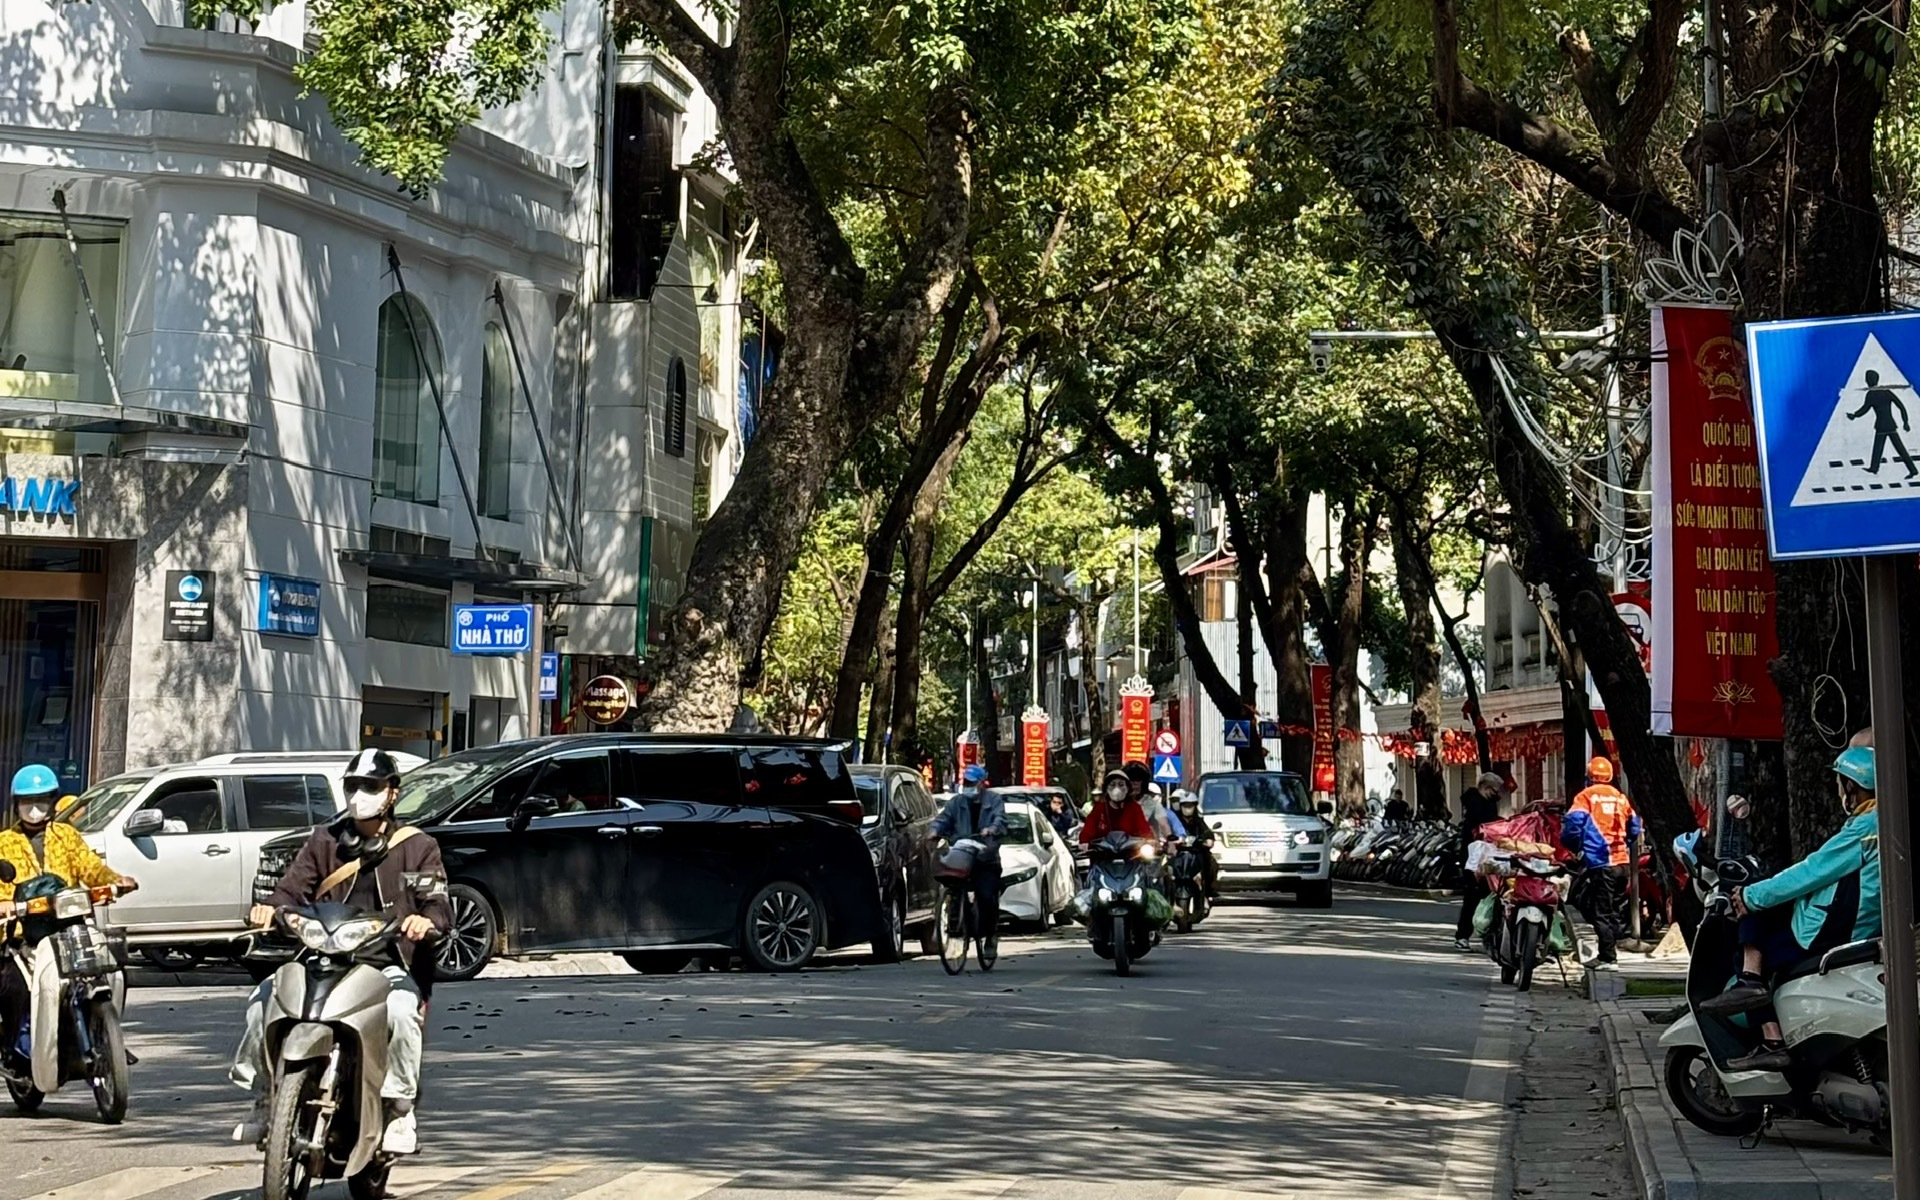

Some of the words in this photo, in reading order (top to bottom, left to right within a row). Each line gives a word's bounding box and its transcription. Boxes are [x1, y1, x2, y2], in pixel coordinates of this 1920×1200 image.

[1702, 414, 1731, 448] QUỐC
[1733, 418, 1751, 452] HỘI
[1690, 457, 1703, 487] LÀ
[1704, 454, 1730, 488] BIỂU
[1731, 462, 1763, 494] TƯỢN
[1676, 499, 1696, 528] SỨC
[1697, 505, 1729, 534] MẠNH
[1731, 506, 1755, 530] TINH
[1696, 546, 1712, 575] ĐẠI
[1714, 542, 1745, 571] ĐOÀN
[1746, 541, 1764, 573] KẾT
[485, 609, 511, 623] PHỐ
[1695, 583, 1721, 613] TOÀN
[1723, 584, 1745, 613] DÂN
[1747, 584, 1766, 620] TỘC
[460, 624, 492, 645] NHÀ
[494, 623, 525, 645] THỜ
[1705, 626, 1728, 660] VIỆT
[1729, 631, 1757, 657] NAM!
